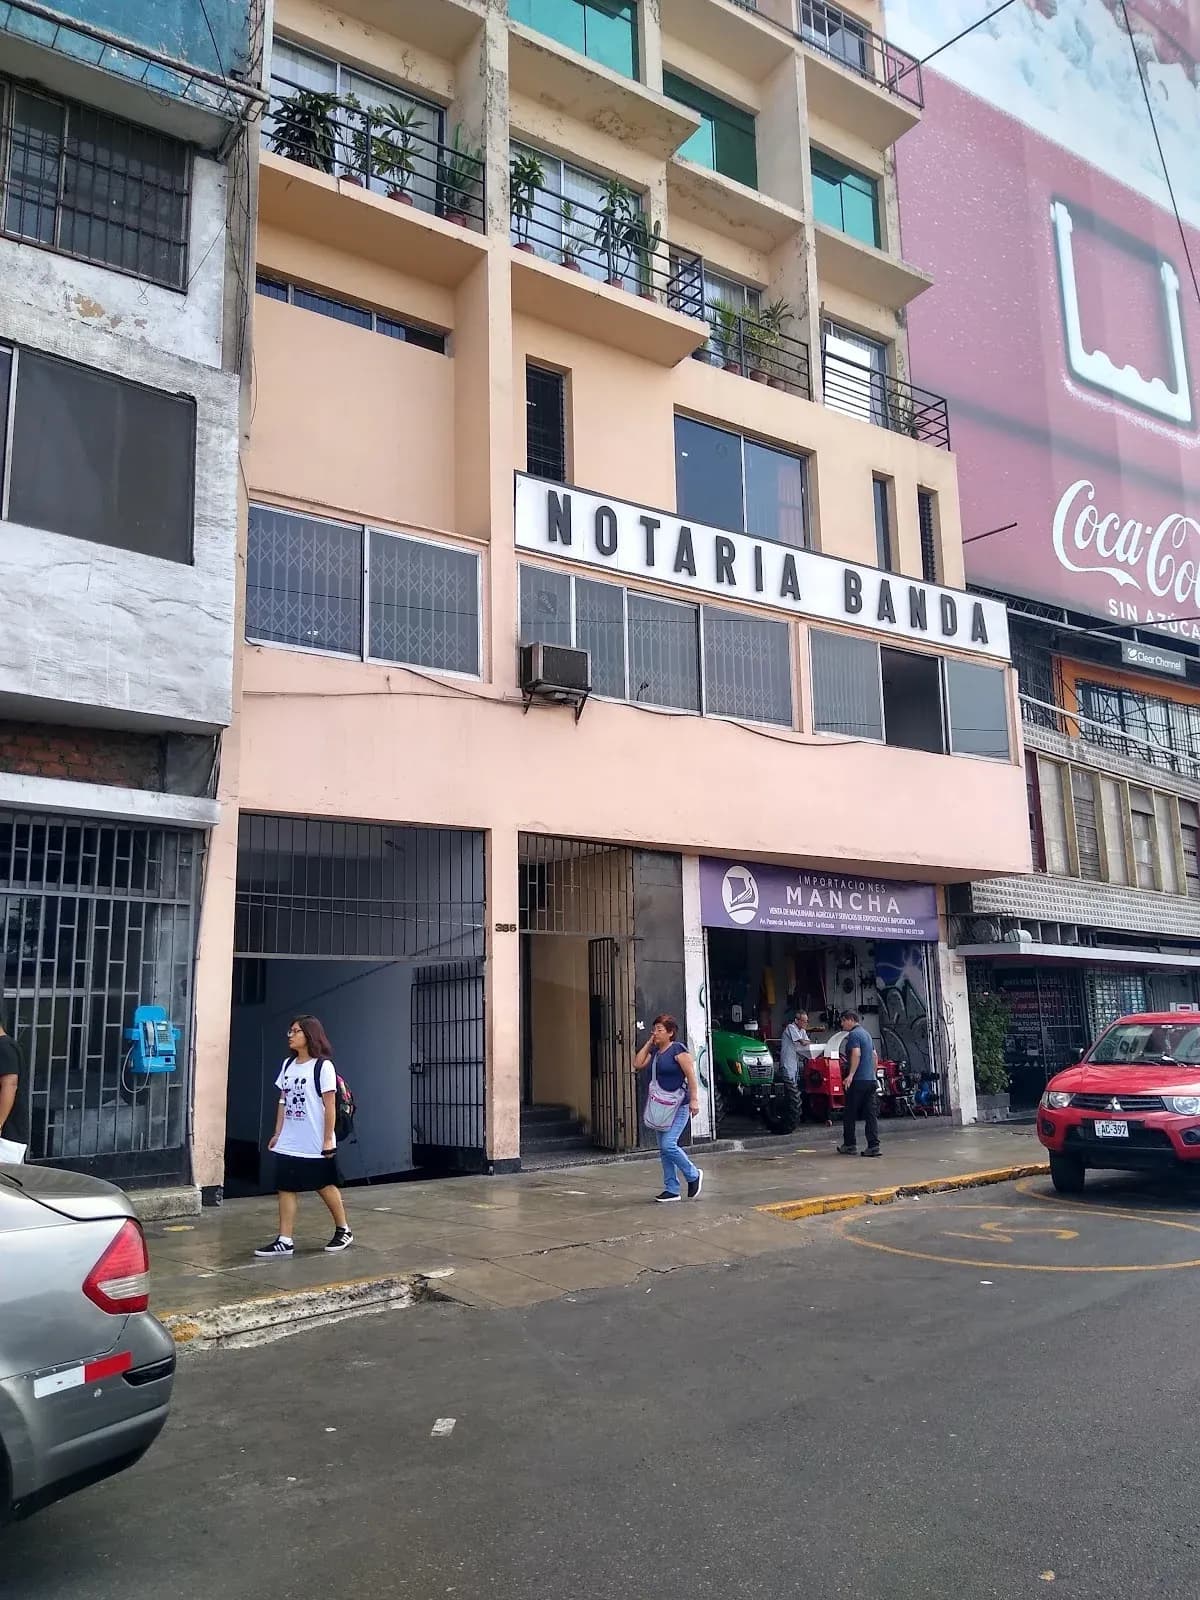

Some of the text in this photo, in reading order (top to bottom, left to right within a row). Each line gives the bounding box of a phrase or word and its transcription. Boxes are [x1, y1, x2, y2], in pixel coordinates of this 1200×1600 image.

[1053, 479, 1200, 608] Coca-Co
[548, 490, 989, 644] NOTARIA BANDA
[1108, 598, 1138, 622] SIN
[1137, 651, 1181, 670] Clear Channel
[799, 875, 886, 894] IMPORTACIONES
[768, 906, 782, 915] VENTA
[786, 886, 900, 914] MANCHA
